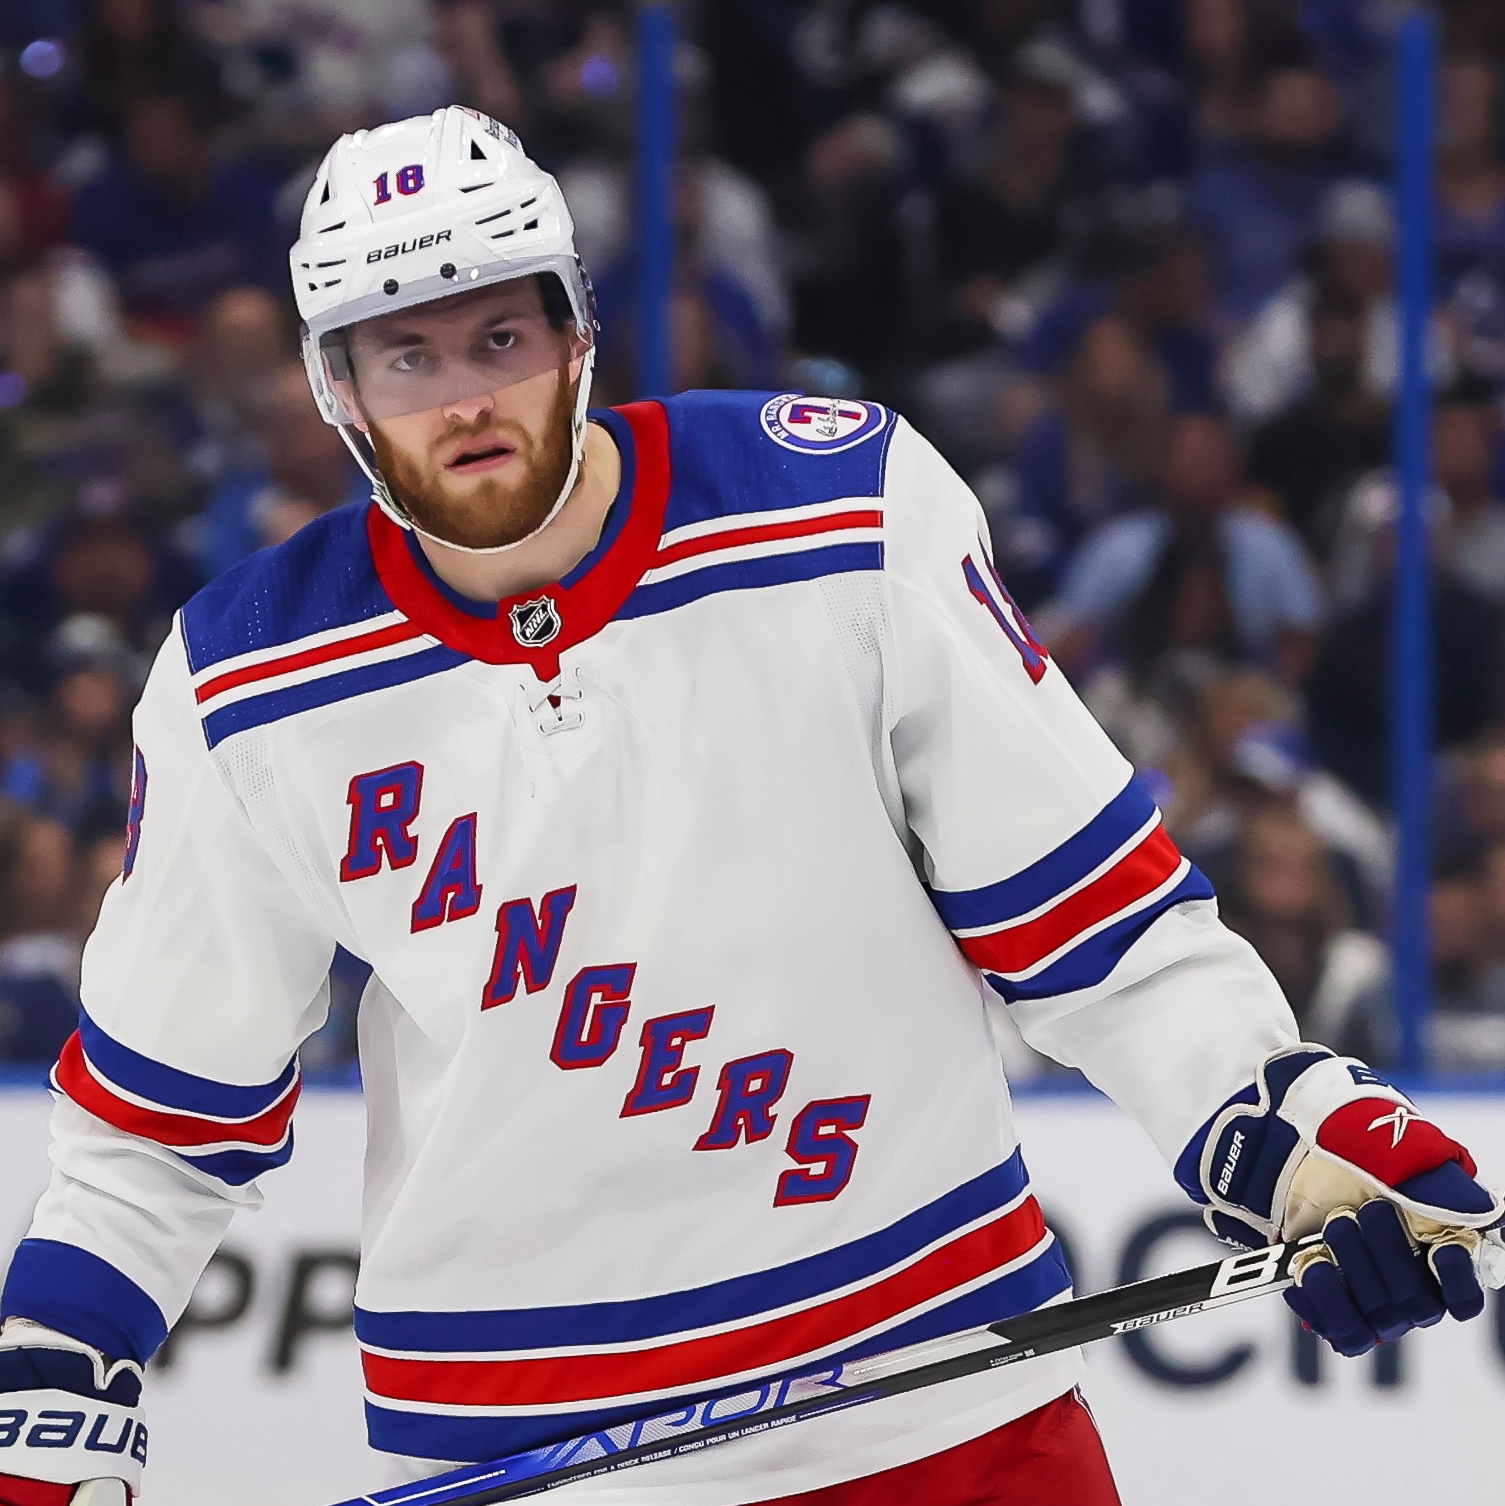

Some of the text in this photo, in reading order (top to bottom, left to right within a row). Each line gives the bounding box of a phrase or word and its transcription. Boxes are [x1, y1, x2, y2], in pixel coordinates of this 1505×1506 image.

[373, 164, 425, 206] 18
[525, 608, 547, 638] NHL
[340, 760, 872, 1207] RANGERS
